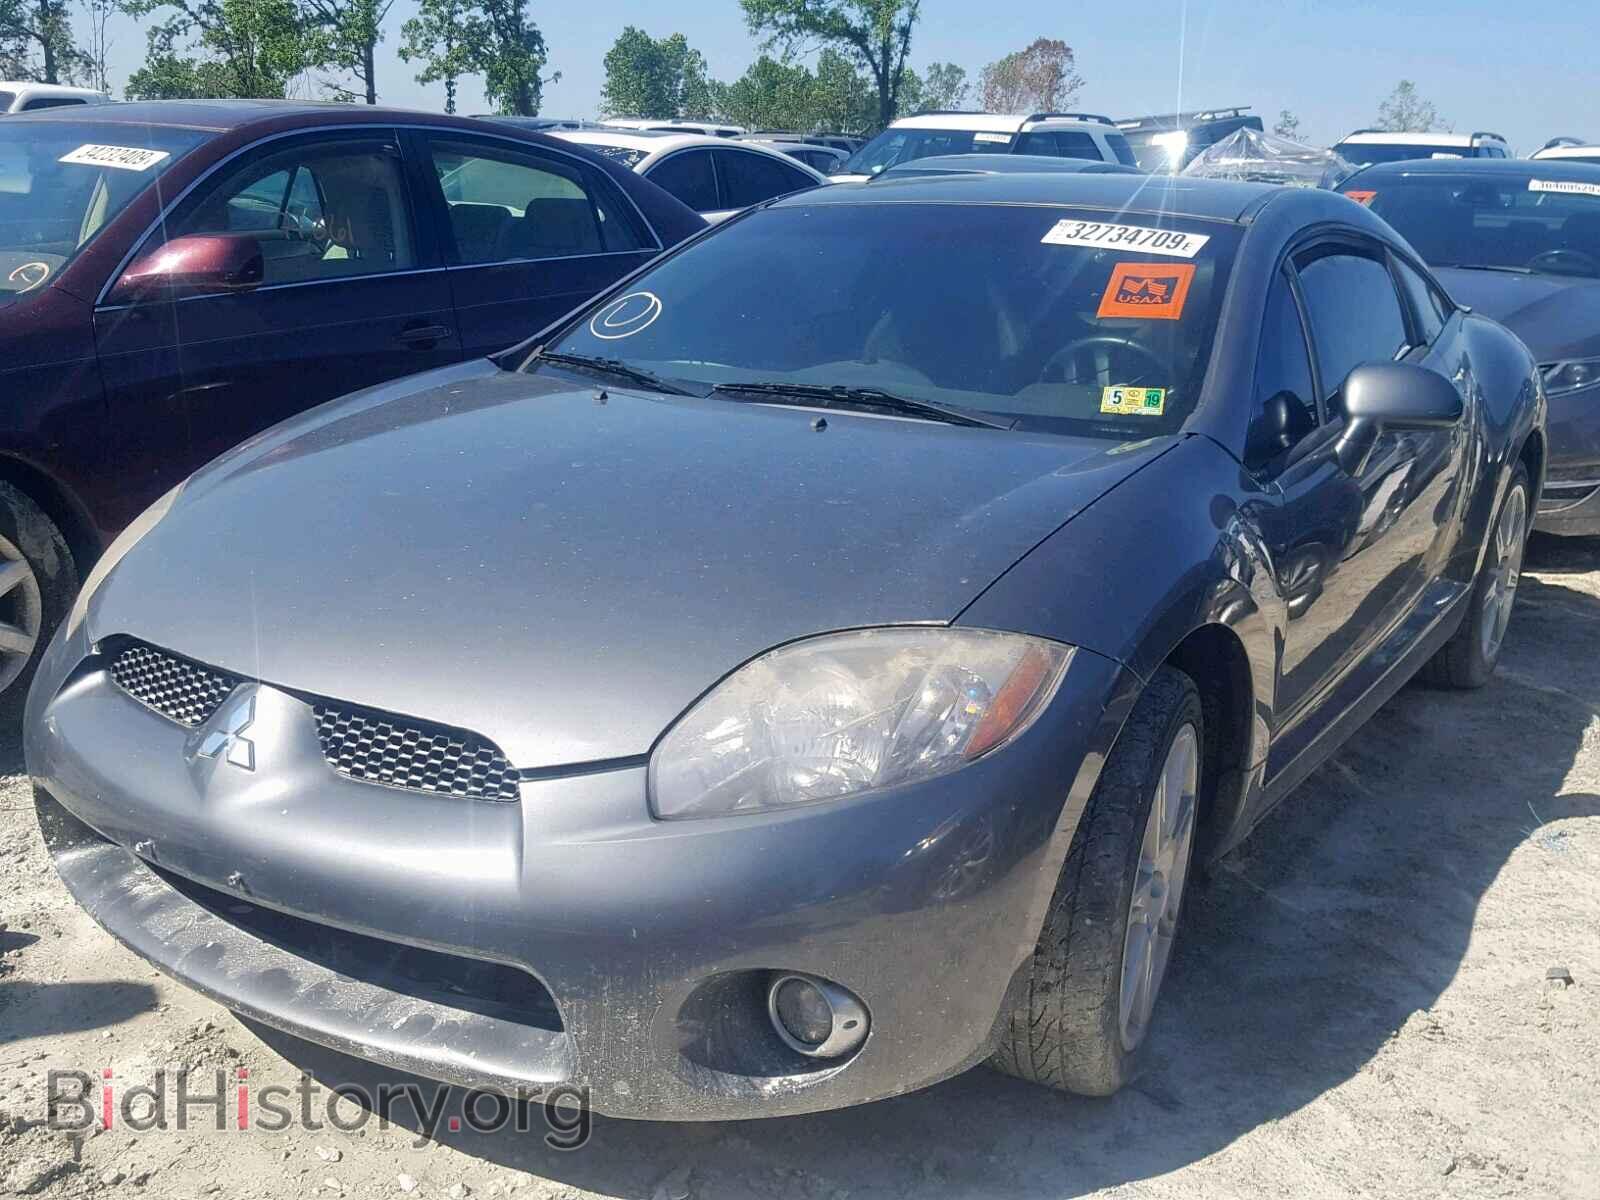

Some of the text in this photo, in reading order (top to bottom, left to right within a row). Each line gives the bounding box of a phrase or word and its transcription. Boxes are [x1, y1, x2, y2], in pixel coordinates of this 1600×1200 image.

[1066, 222, 1187, 250] 32734709
[1118, 294, 1164, 304] USAA
[1112, 390, 1122, 405] 5
[1146, 393, 1160, 406] 19
